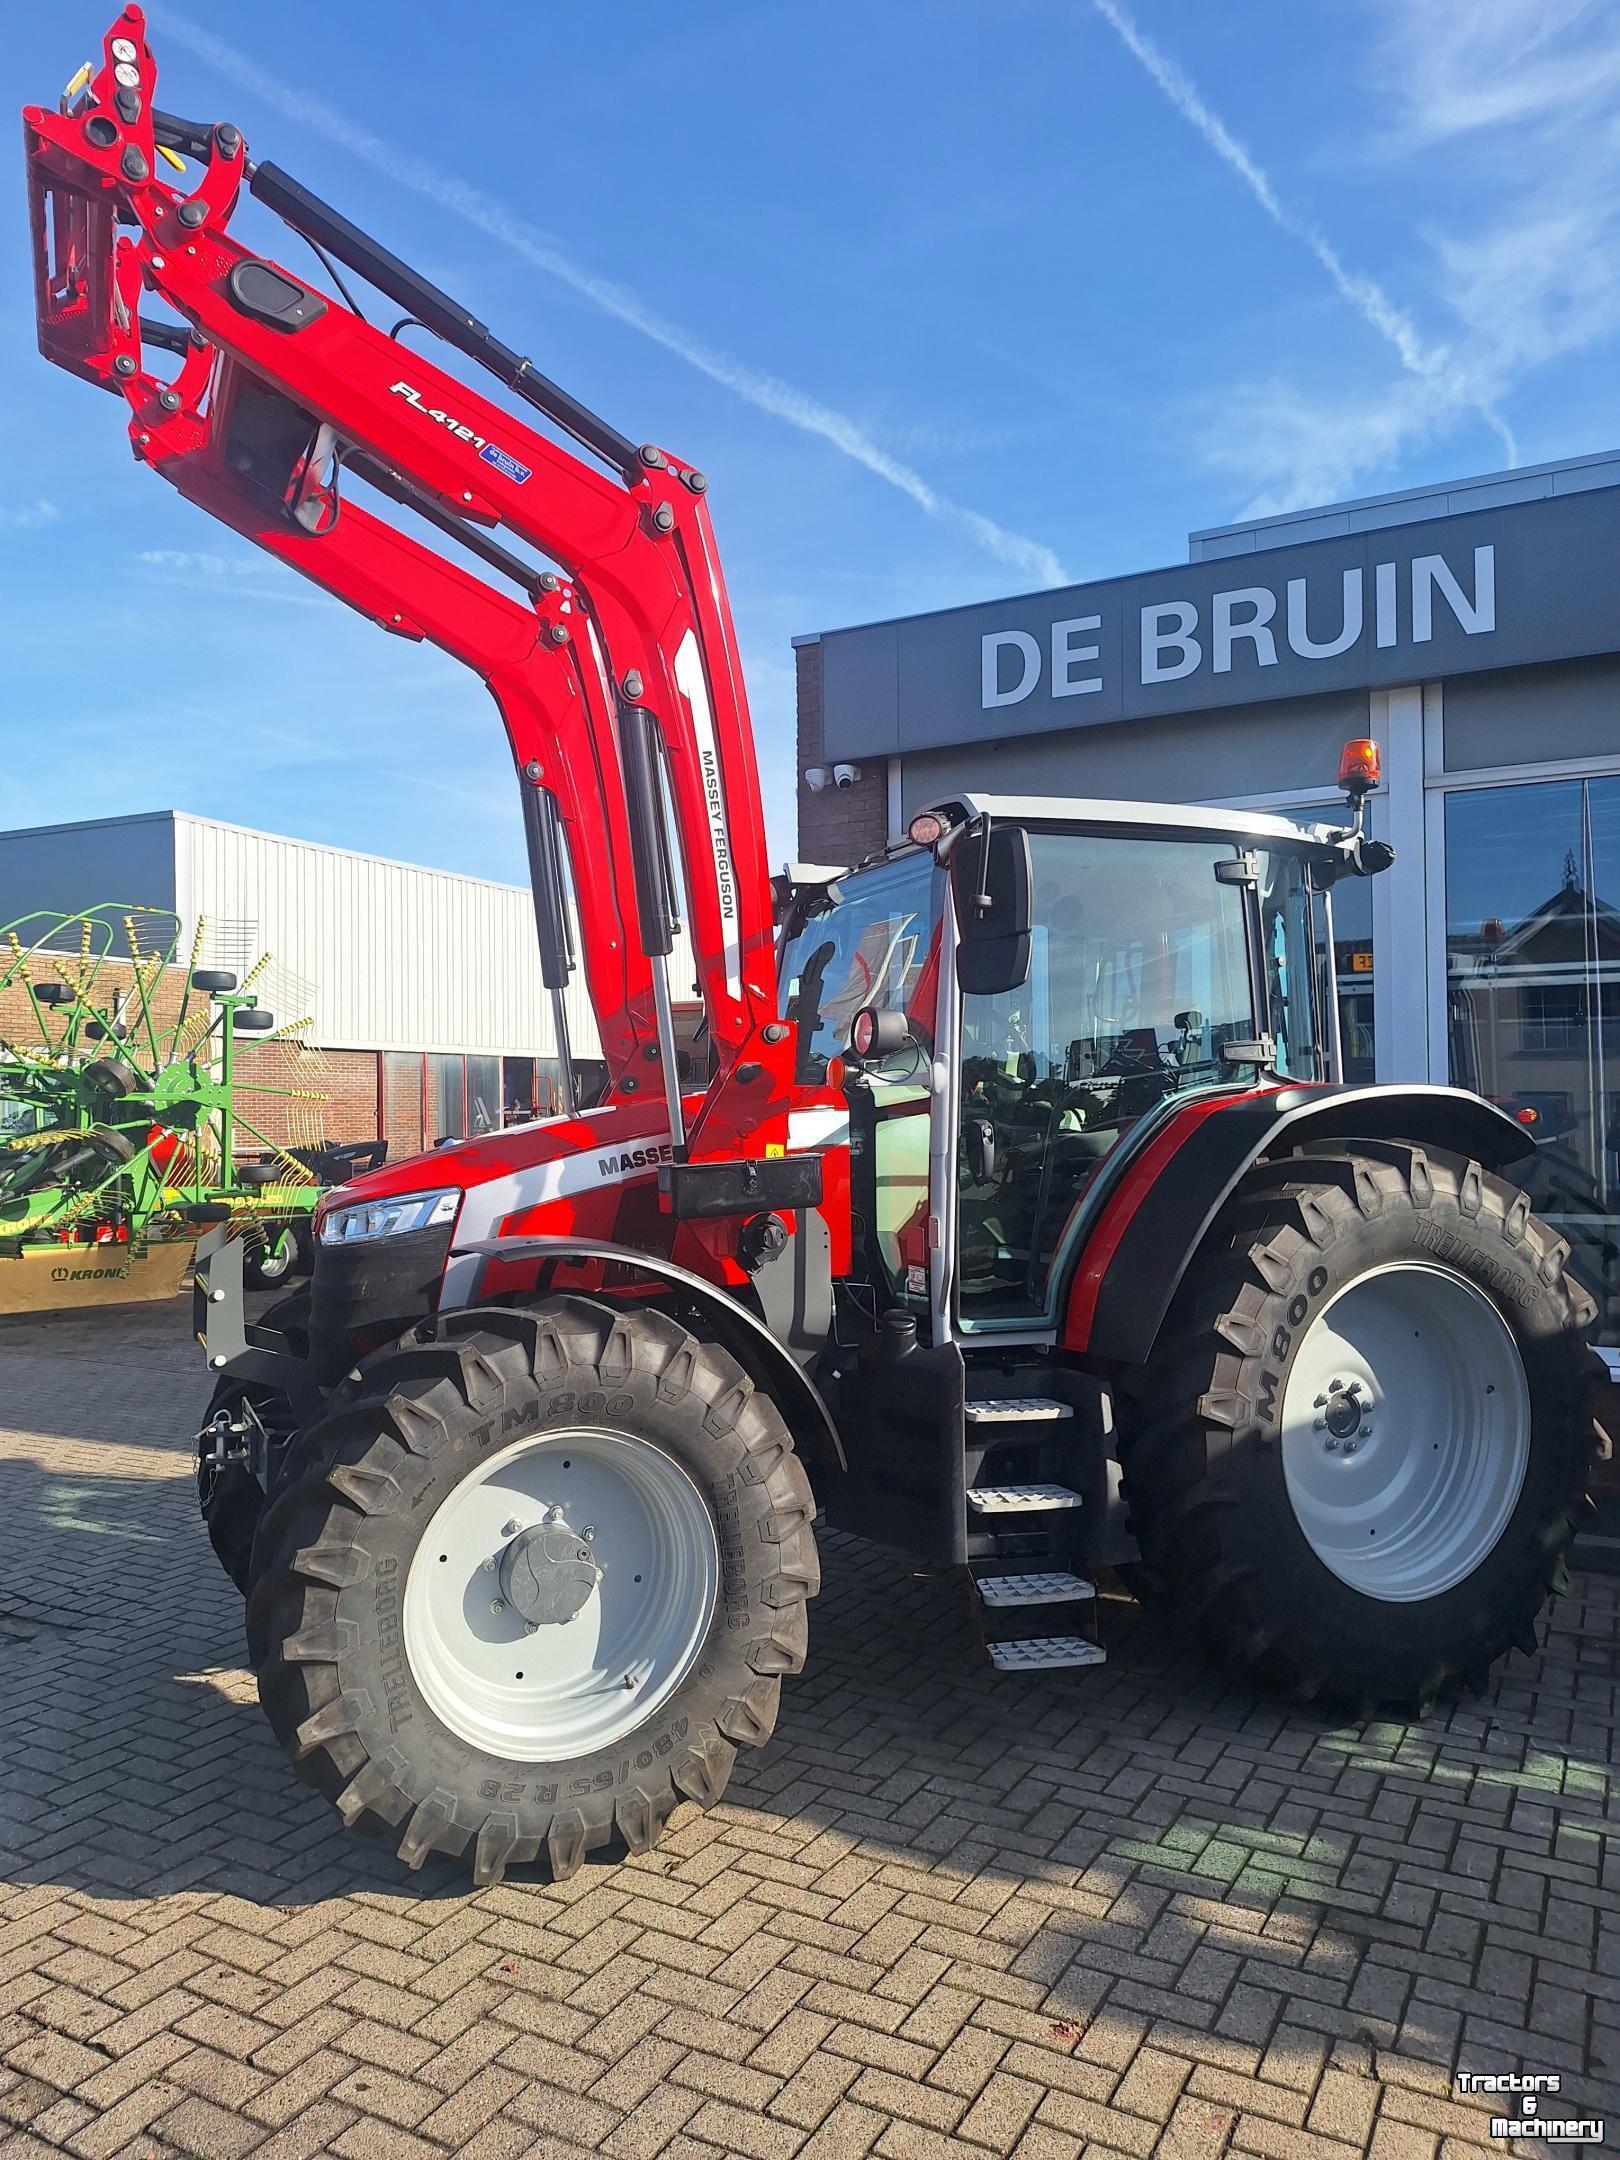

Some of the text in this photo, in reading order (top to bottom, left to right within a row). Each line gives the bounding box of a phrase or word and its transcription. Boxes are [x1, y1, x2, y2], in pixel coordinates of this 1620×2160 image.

[981, 545, 1496, 709] DE BRUIN
[703, 750, 734, 919] MASSEY FERGUSON
[598, 1144, 673, 1177] MASSE
[1410, 1216, 1540, 1309] TRELLEBORG
[712, 1473, 750, 1630] TRELLEBORG
[375, 1557, 413, 1735] TRELLEBORG
